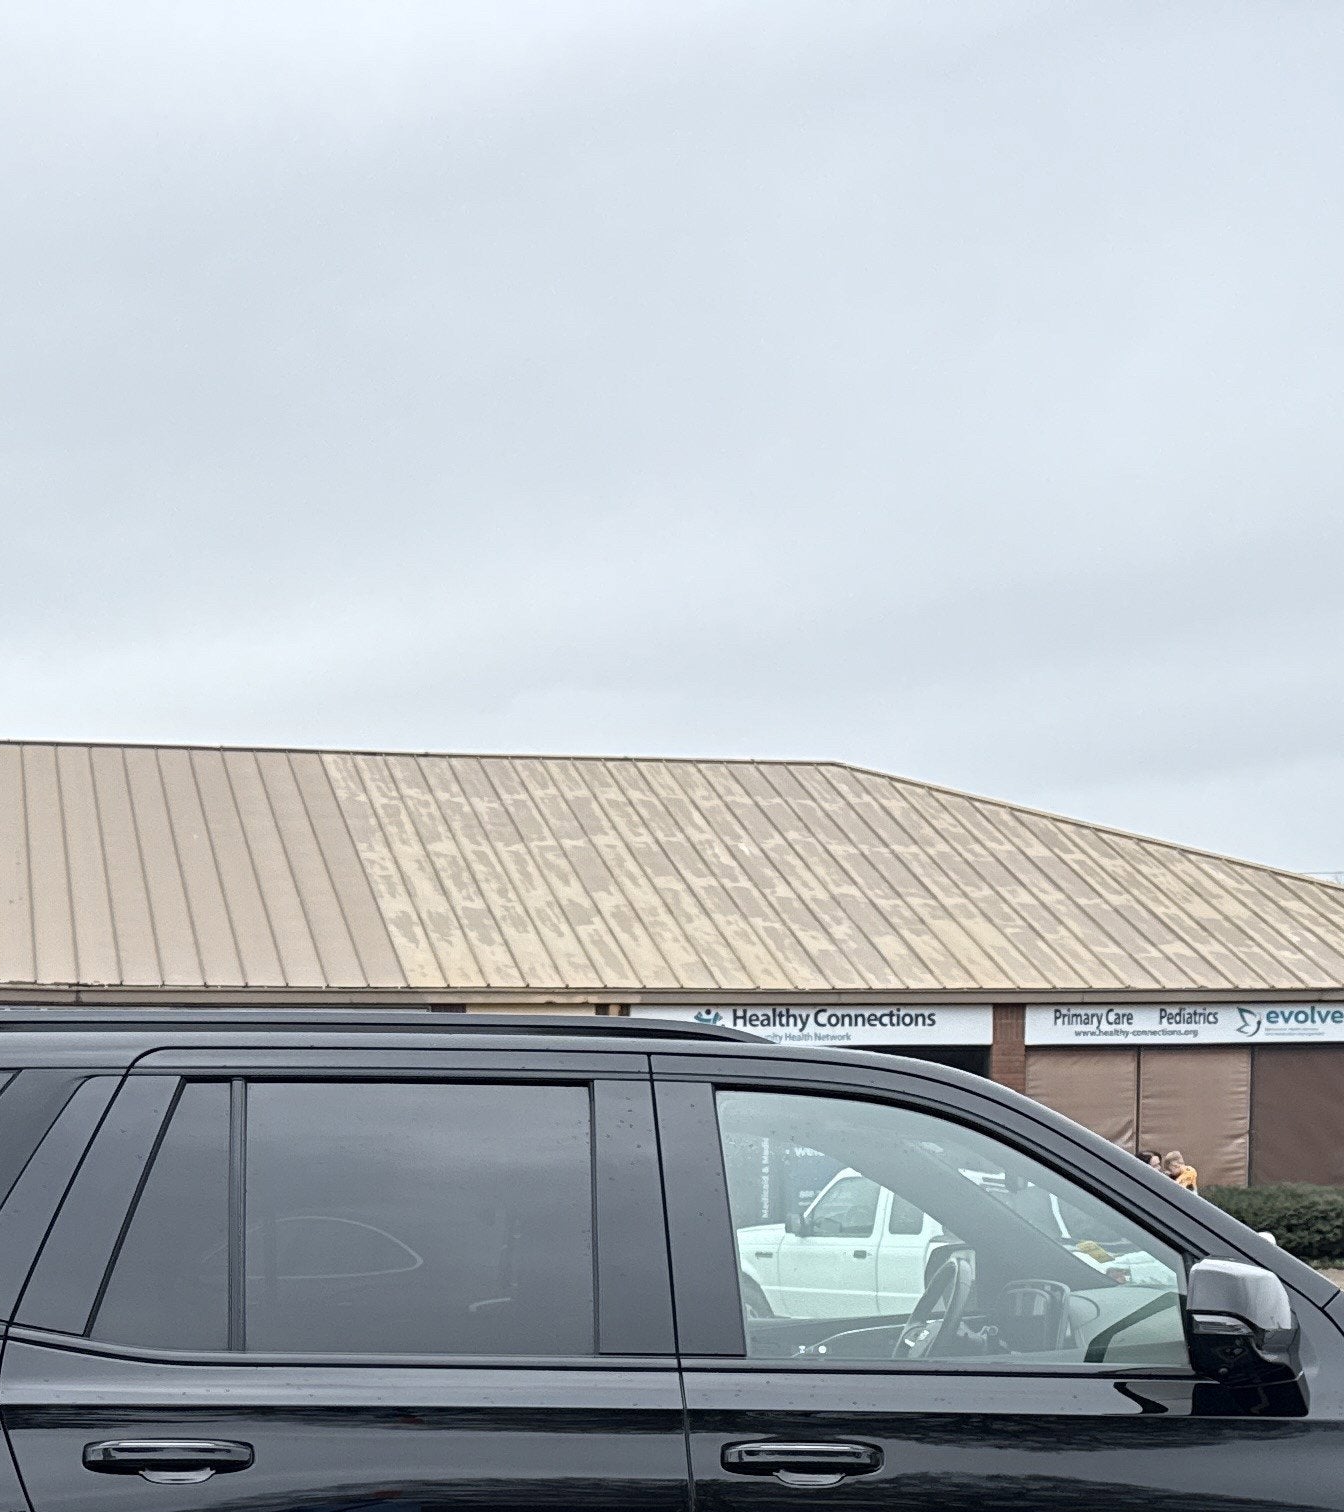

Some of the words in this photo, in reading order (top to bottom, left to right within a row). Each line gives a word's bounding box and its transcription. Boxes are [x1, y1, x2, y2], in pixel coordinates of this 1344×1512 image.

[732, 1008, 810, 1032] Healthy
[814, 1008, 936, 1027] Connections
[1053, 1008, 1103, 1030] Primary
[1106, 1008, 1134, 1025] Care
[1159, 1007, 1219, 1025] Pediatrics
[1266, 1005, 1344, 1024] evolve
[784, 1032, 812, 1042] Health
[814, 1032, 852, 1042] Network
[1074, 1028, 1199, 1039] www.healthy-connections.org
